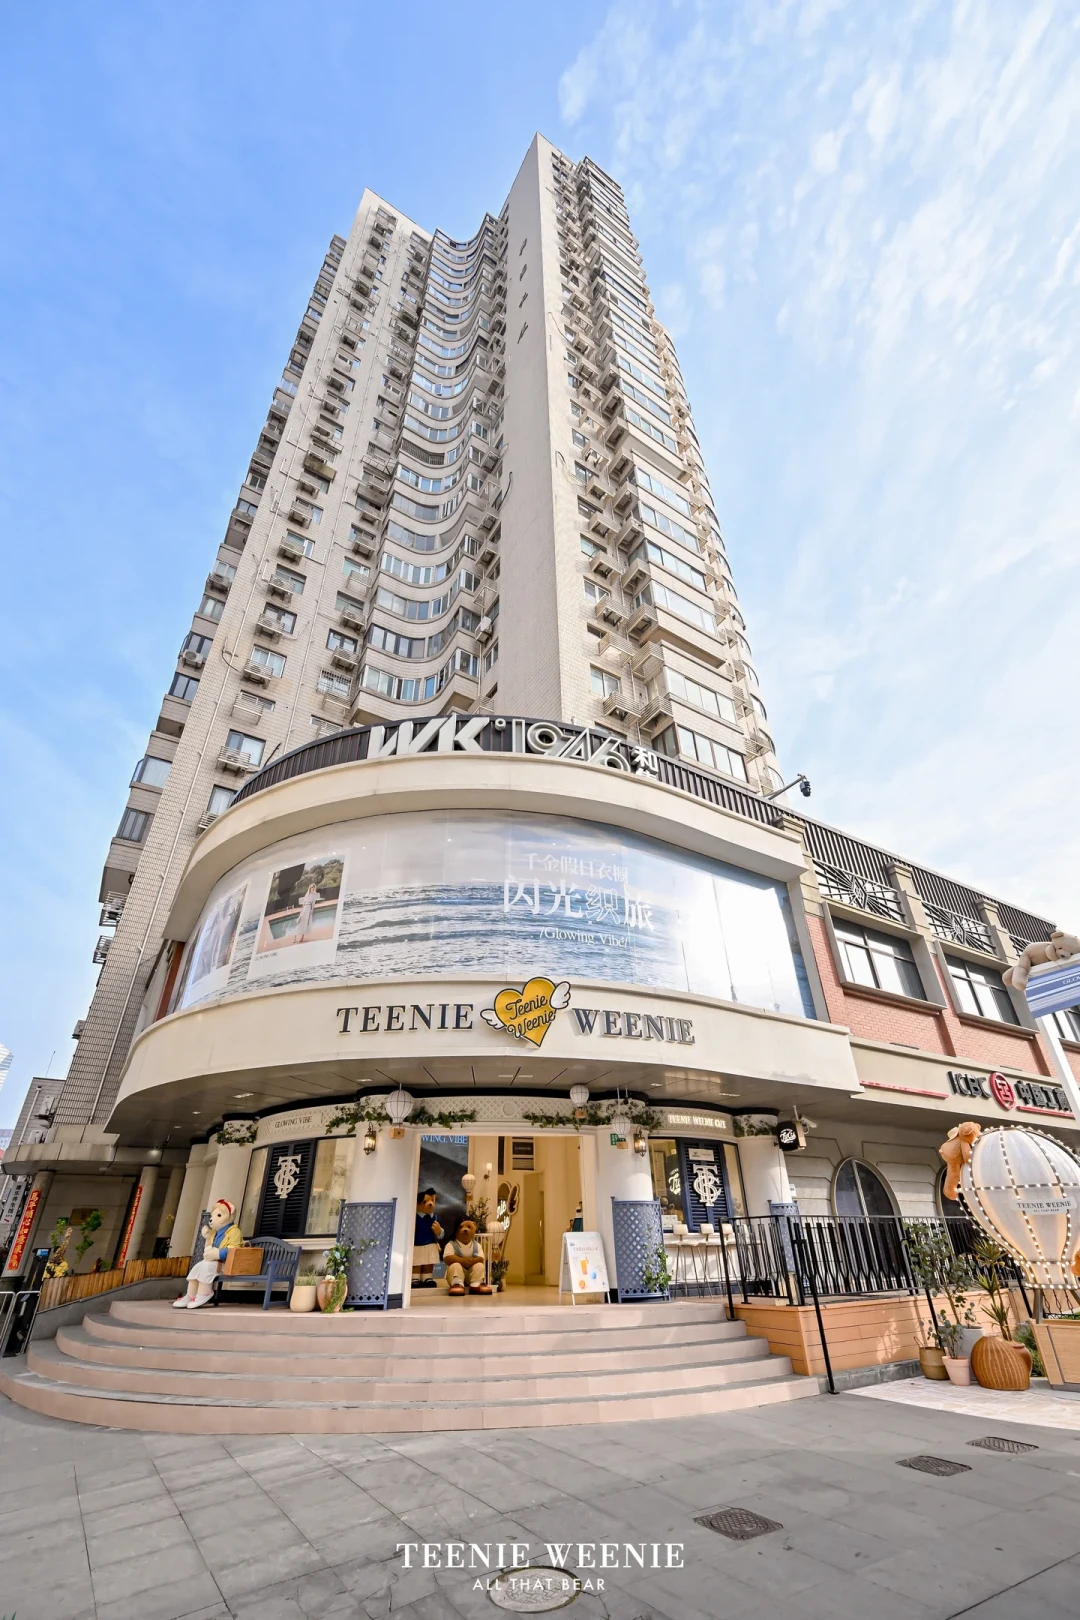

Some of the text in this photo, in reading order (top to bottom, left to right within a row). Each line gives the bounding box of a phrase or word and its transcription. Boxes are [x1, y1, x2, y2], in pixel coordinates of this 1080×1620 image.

[502, 874, 655, 932] 闪光织旅
[505, 994, 549, 1021] Teenie
[337, 1003, 696, 1045] TEENIE WEENIE
[507, 1009, 556, 1038] Weenie
[946, 1070, 993, 1099] ICBC
[1045, 1200, 1071, 1208] WEENIE
